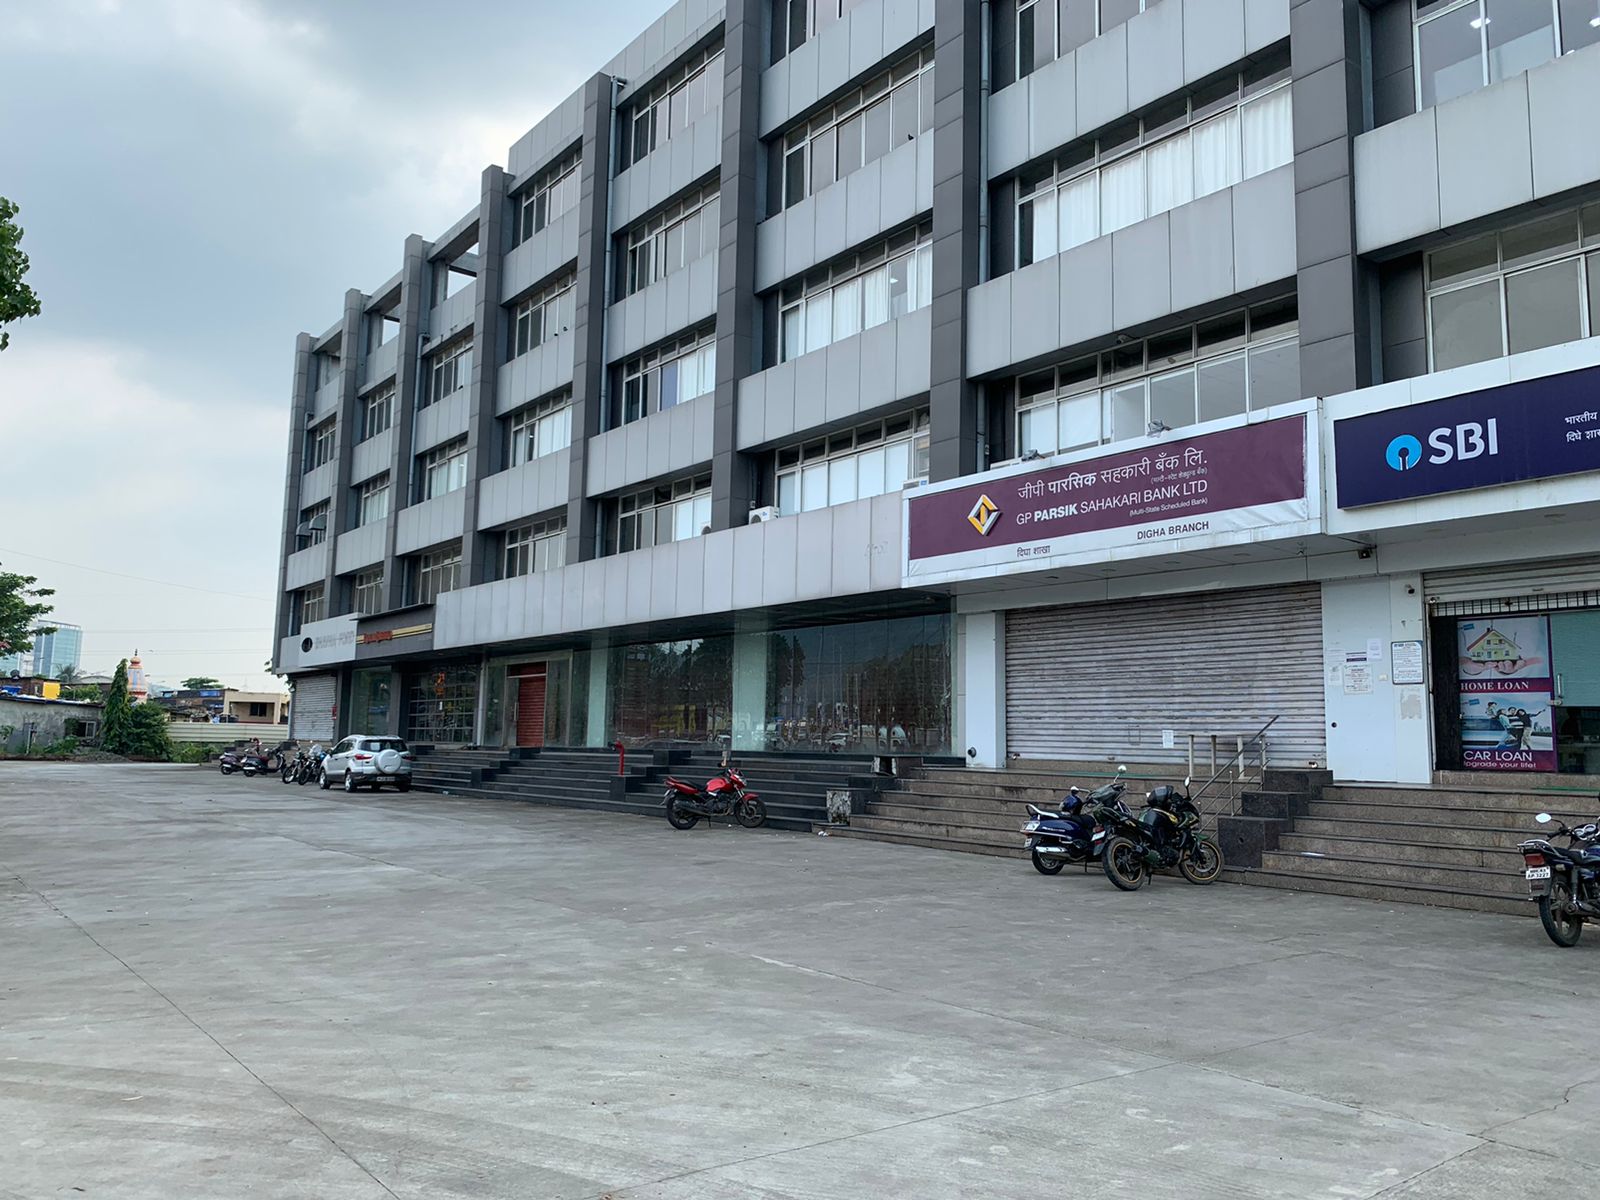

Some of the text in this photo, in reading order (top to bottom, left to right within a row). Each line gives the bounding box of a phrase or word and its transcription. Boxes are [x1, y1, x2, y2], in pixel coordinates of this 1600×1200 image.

[1565, 411, 1598, 424] भारतीय
[1428, 418, 1498, 465] SBI
[1017, 447, 1208, 499] जीपी पारसिक सहकारी बँक लि.
[1016, 479, 1208, 525] GP PARSIK SAHAKARI BANK LTD
[1129, 496, 1208, 518] (Multi-State Scheduled Bank)
[1137, 521, 1209, 540] DIGHA BRANCH
[1461, 681, 1529, 691] HOME LOAN
[1463, 751, 1532, 762] CAR LOAN
